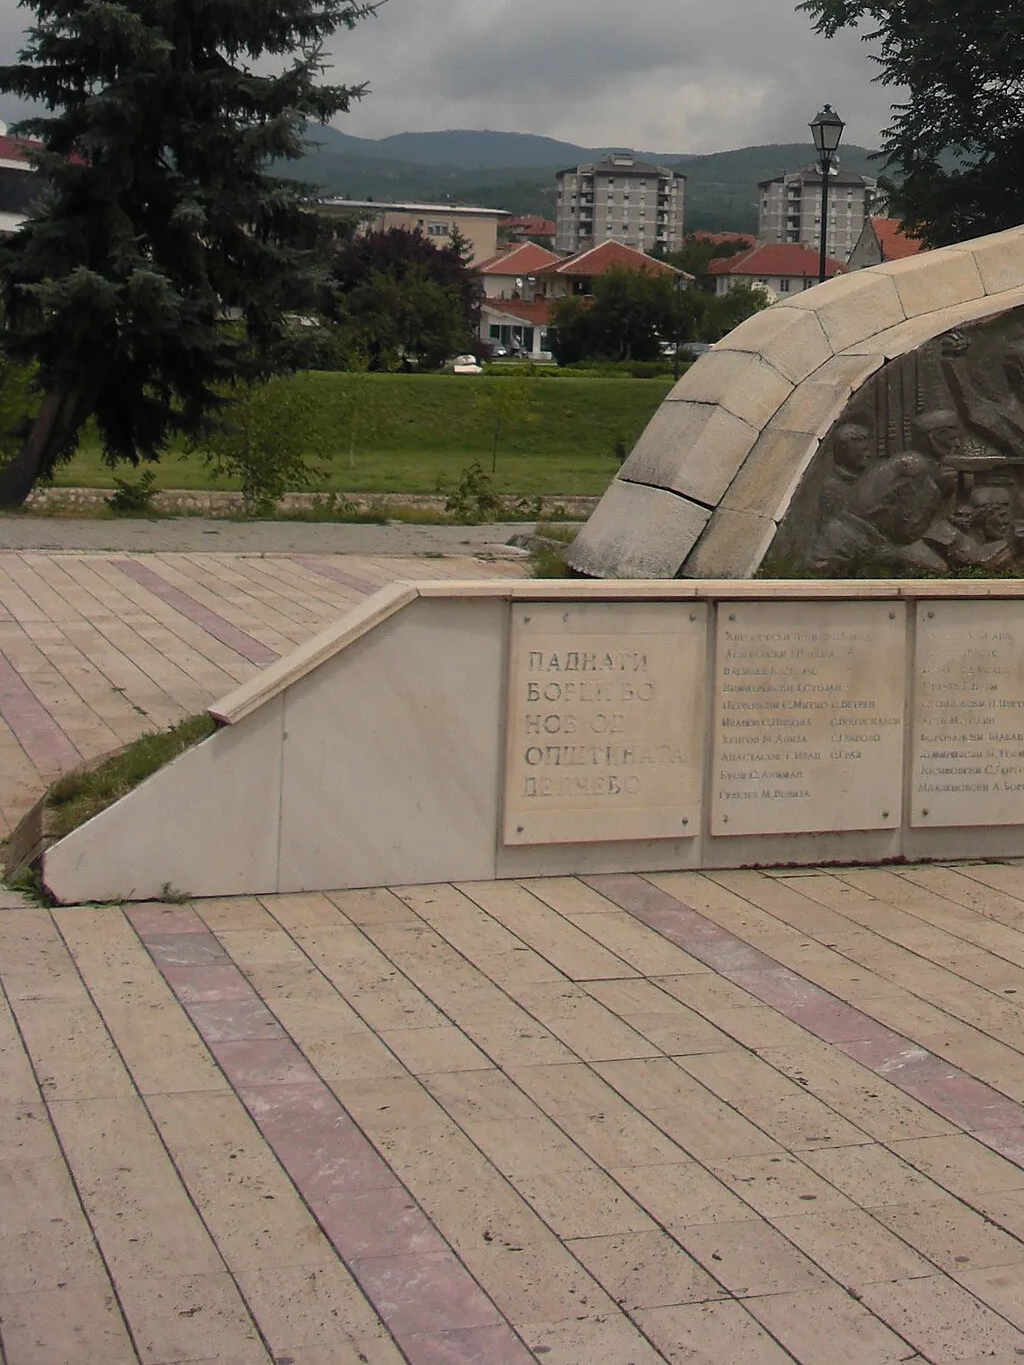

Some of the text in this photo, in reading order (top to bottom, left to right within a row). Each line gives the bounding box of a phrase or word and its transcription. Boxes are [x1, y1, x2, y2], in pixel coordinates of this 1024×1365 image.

[528, 651, 648, 671] ПАДНАТИ
[526, 682, 655, 702] БОРЦИ ВО
[525, 714, 578, 734] НОВ
[525, 746, 686, 765] ОПШТИНАТА
[522, 776, 641, 797] ДЕЛЧЕВО
